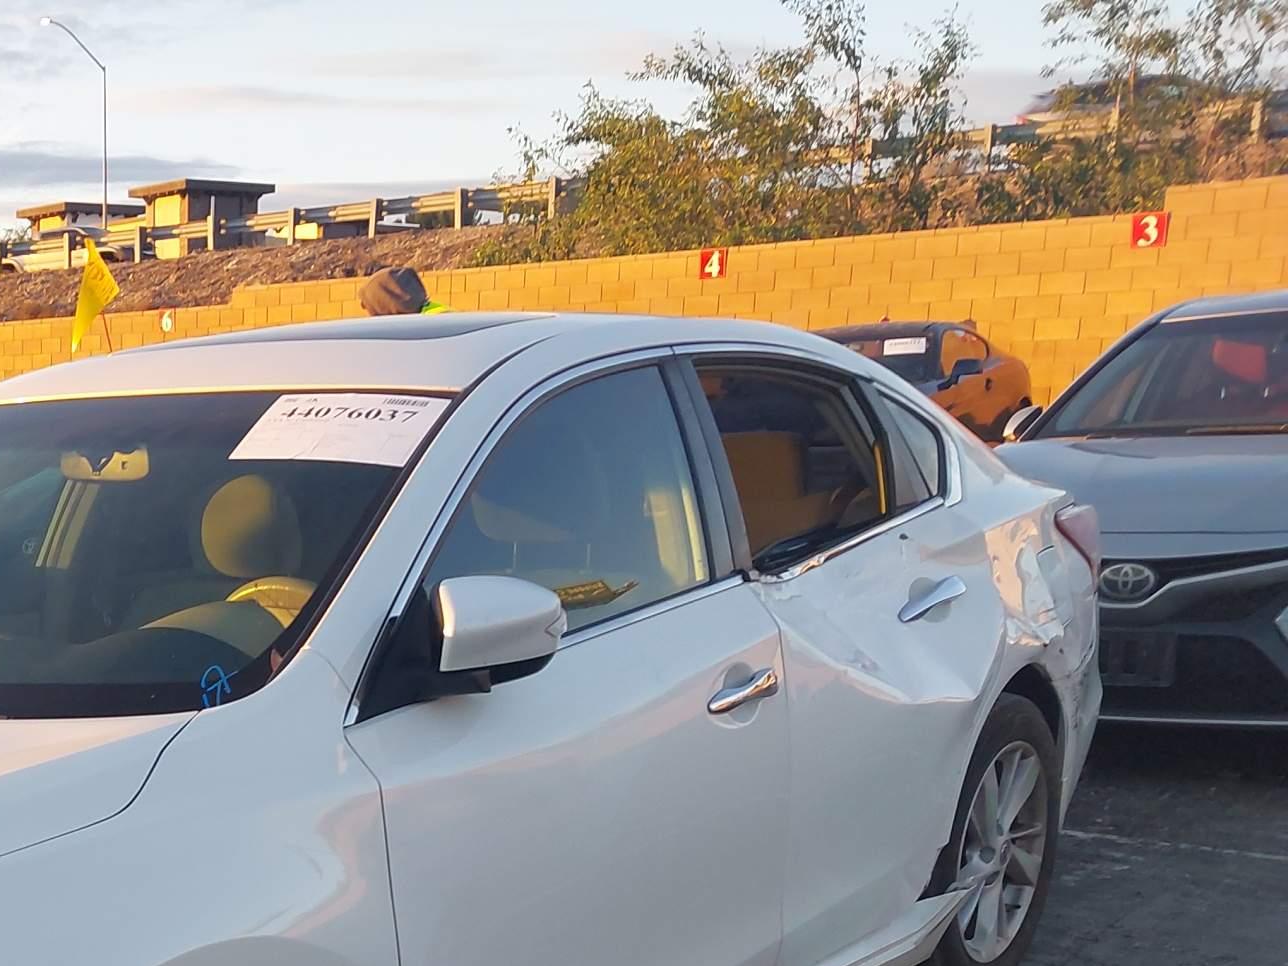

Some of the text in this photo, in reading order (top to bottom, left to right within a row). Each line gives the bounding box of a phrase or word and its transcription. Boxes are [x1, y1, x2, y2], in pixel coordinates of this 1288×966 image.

[1137, 215, 1159, 248] 3
[704, 250, 721, 278] 4
[161, 310, 173, 333] 6
[281, 406, 419, 424] 44076037
